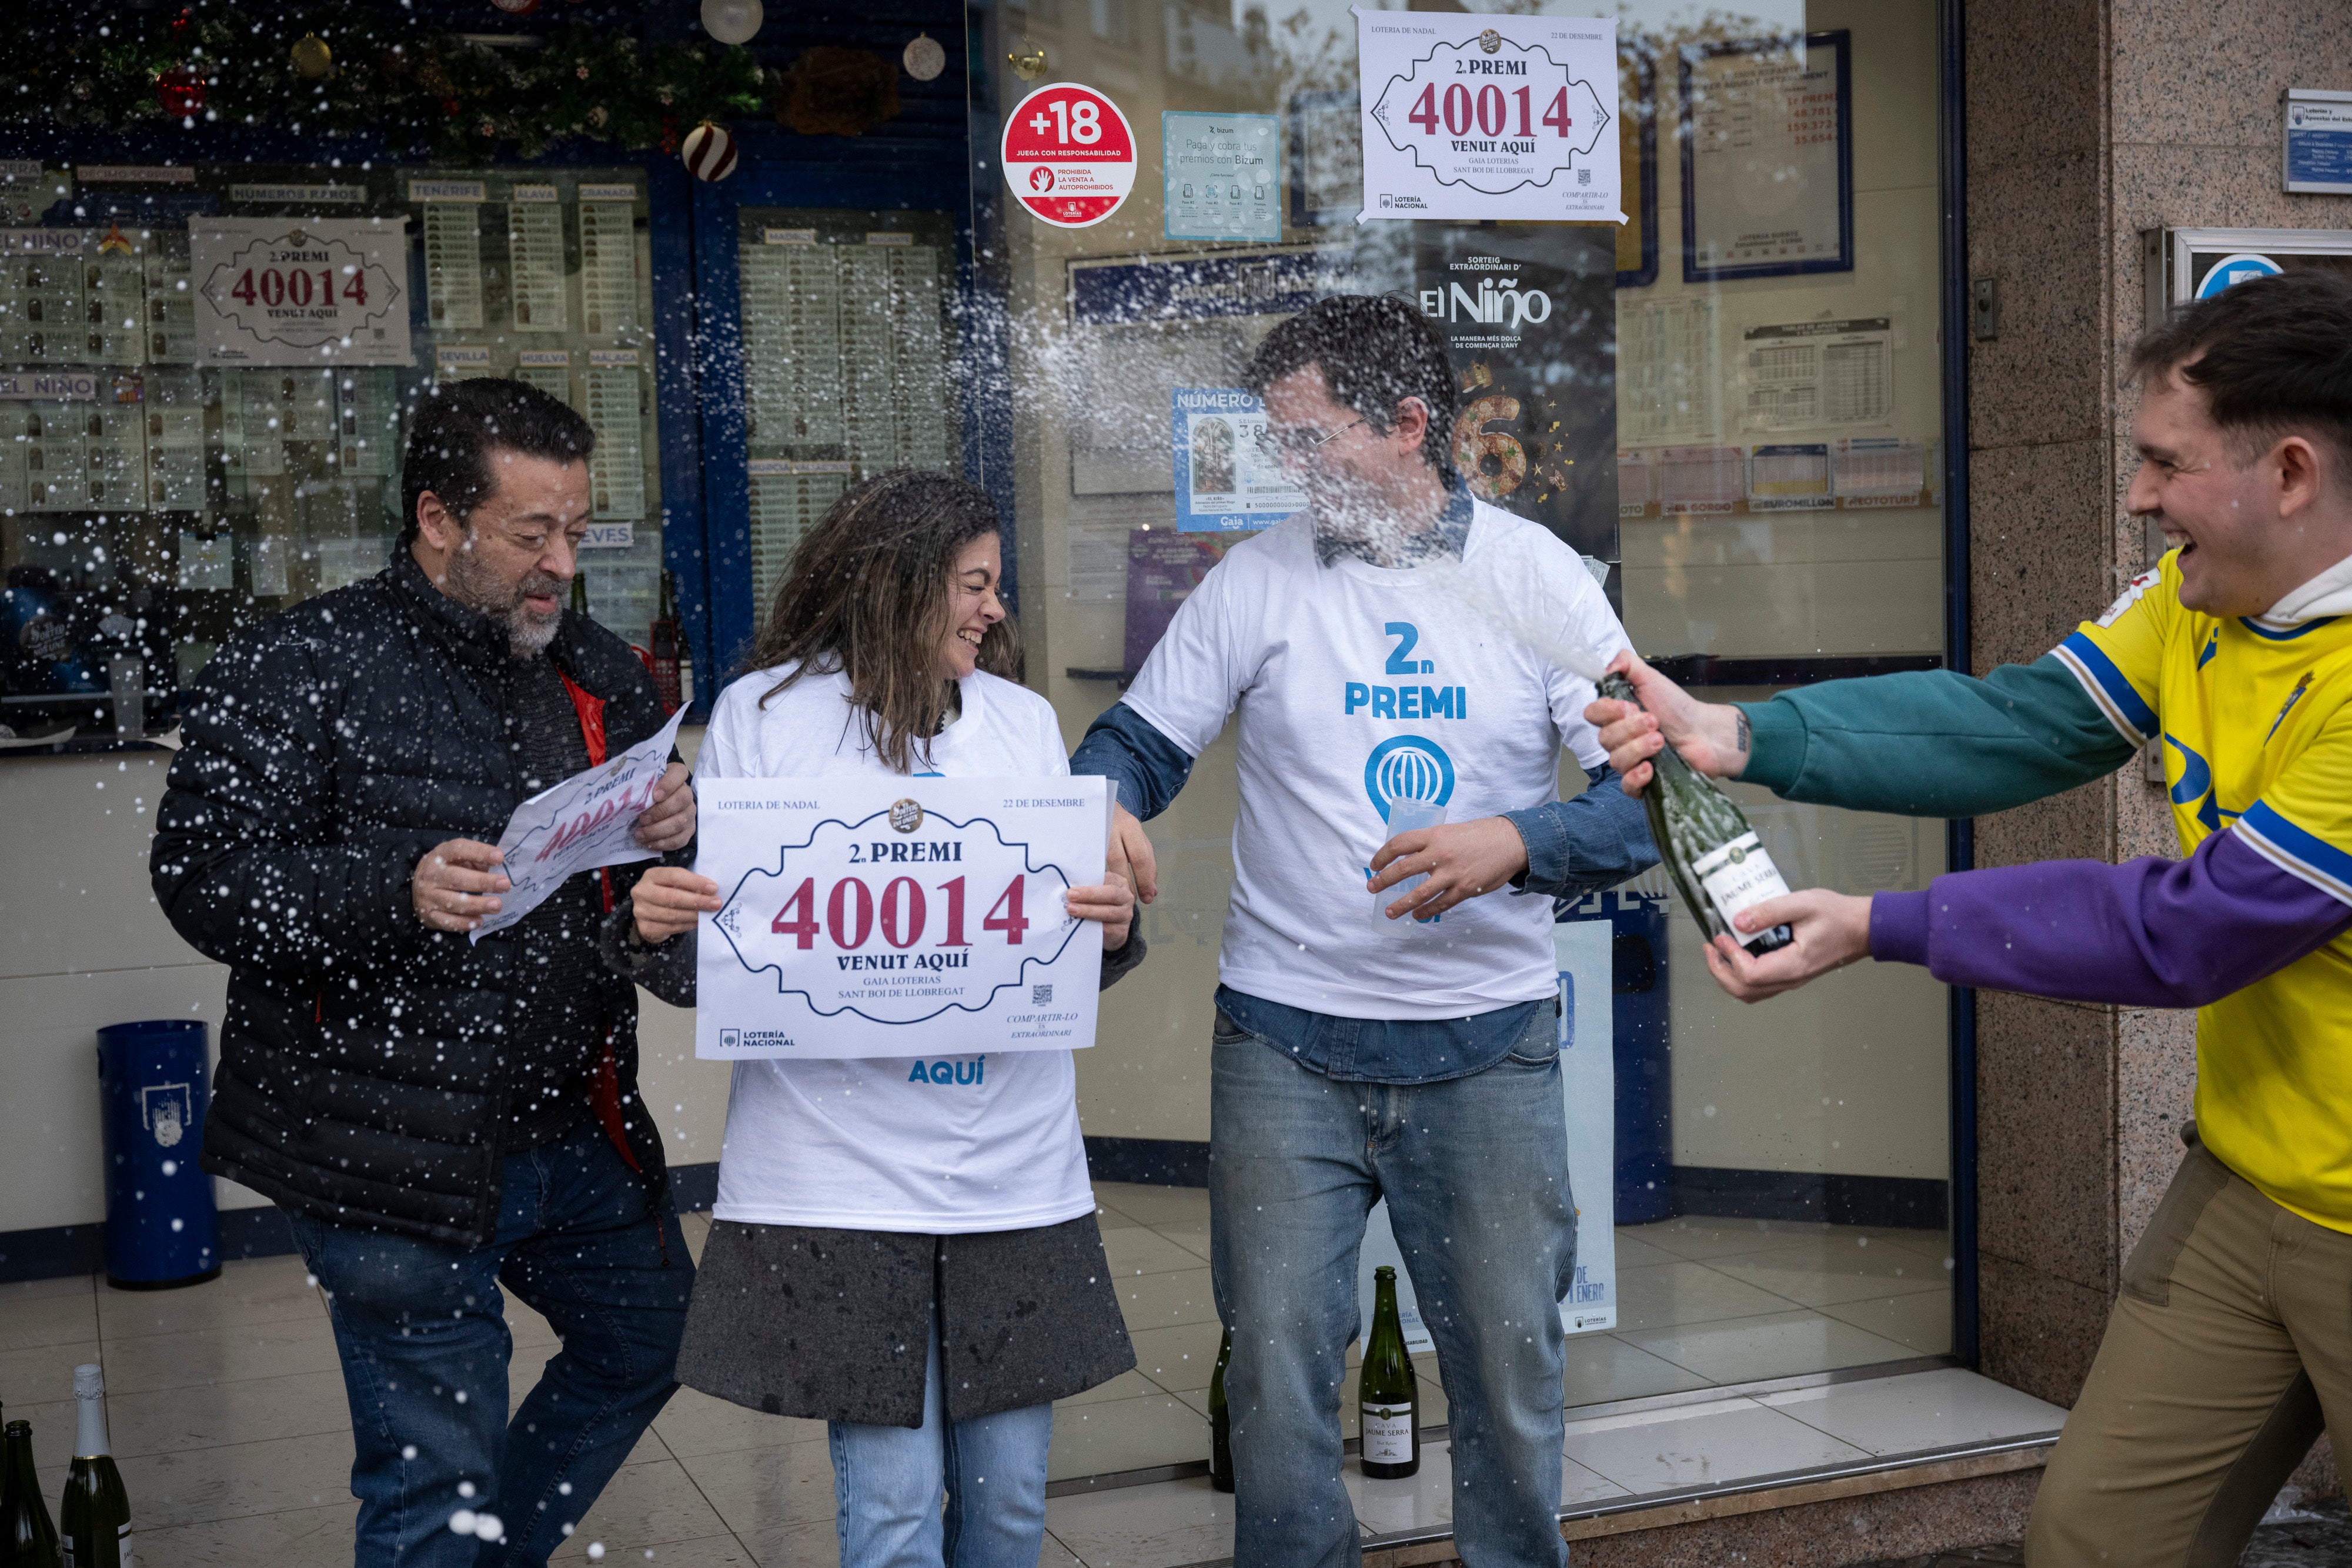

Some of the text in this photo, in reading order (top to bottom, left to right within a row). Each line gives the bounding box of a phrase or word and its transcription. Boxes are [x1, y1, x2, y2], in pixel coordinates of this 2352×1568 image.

[1469, 60, 1527, 75] PREMI
[1409, 82, 1572, 138] 40014
[1030, 101, 1102, 145] +18
[1187, 139, 1257, 151] Paga y cobra tus
[1451, 139, 1535, 156] VENUT AQUÍ
[1180, 155, 1214, 165] premios
[1235, 155, 1263, 165] Bizum
[415, 184, 482, 197] TENERIFE
[580, 188, 634, 198] GRANADA
[22, 230, 79, 248] NIÑO
[282, 251, 329, 262] PREMI
[231, 268, 369, 307] 40014
[1420, 278, 1552, 329] El Niño
[439, 352, 487, 362] SEVILLA
[522, 353, 567, 363] HUELVA
[34, 376, 91, 394] NIÑO
[1177, 391, 1253, 407] NÚMERO
[1221, 516, 1244, 529] Gaia
[1384, 621, 1434, 675] 2n
[1345, 681, 1466, 720] PREMI
[594, 767, 637, 798] PREMI
[718, 801, 820, 810] LOTERIA DE NADAL
[1003, 798, 1085, 808] 22 DE DESEMBRE
[870, 842, 962, 862] PREMI
[771, 874, 1029, 950] 40014
[837, 948, 969, 972] VENUT AQUÍ
[863, 976, 941, 986] GAIA LOTERIAS
[838, 987, 965, 999] SANT BOI DE LLOBREGAT
[1007, 1012, 1078, 1024] COMPARTIR-LO
[743, 1030, 784, 1039] LOTERÍA
[1011, 1029, 1071, 1039] EXTRAORDINARI
[743, 1038, 795, 1047] NACIONAL
[908, 1055, 985, 1085] AQUÍ
[1576, 1266, 1588, 1284] DE
[1366, 1428, 1386, 1436] JAUME
